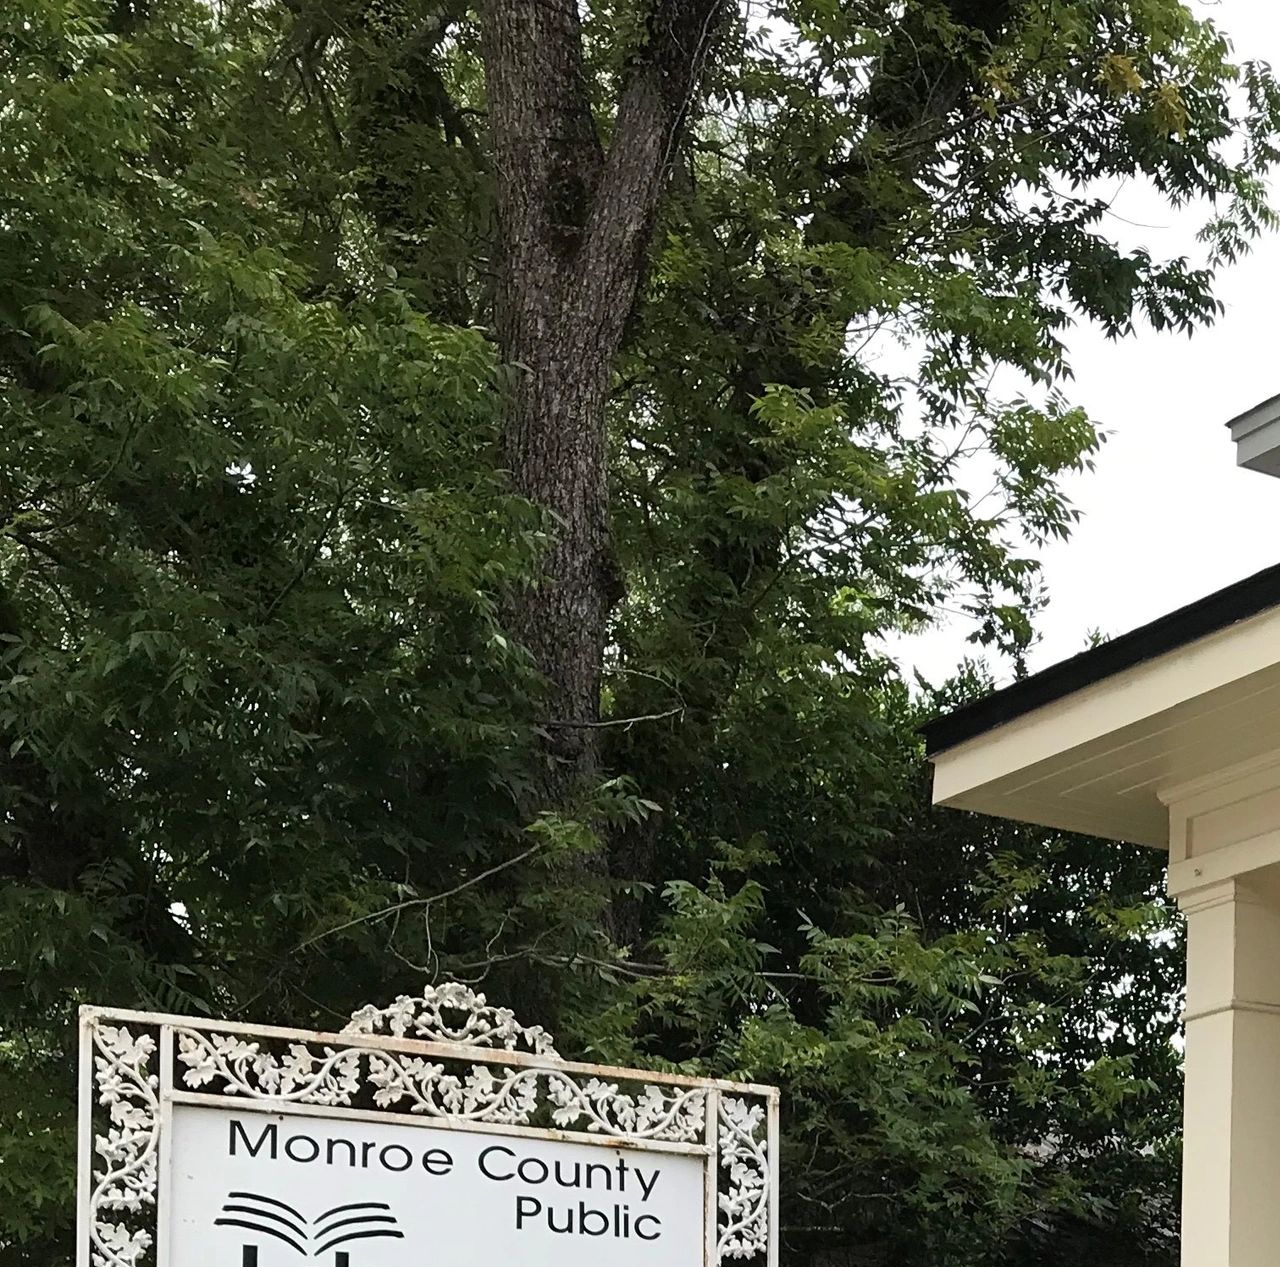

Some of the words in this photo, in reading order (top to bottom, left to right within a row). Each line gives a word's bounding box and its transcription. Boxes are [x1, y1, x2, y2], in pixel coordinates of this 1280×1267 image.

[229, 1120, 454, 1175] Monroe
[479, 1145, 661, 1201] County
[516, 1195, 662, 1241] Public
